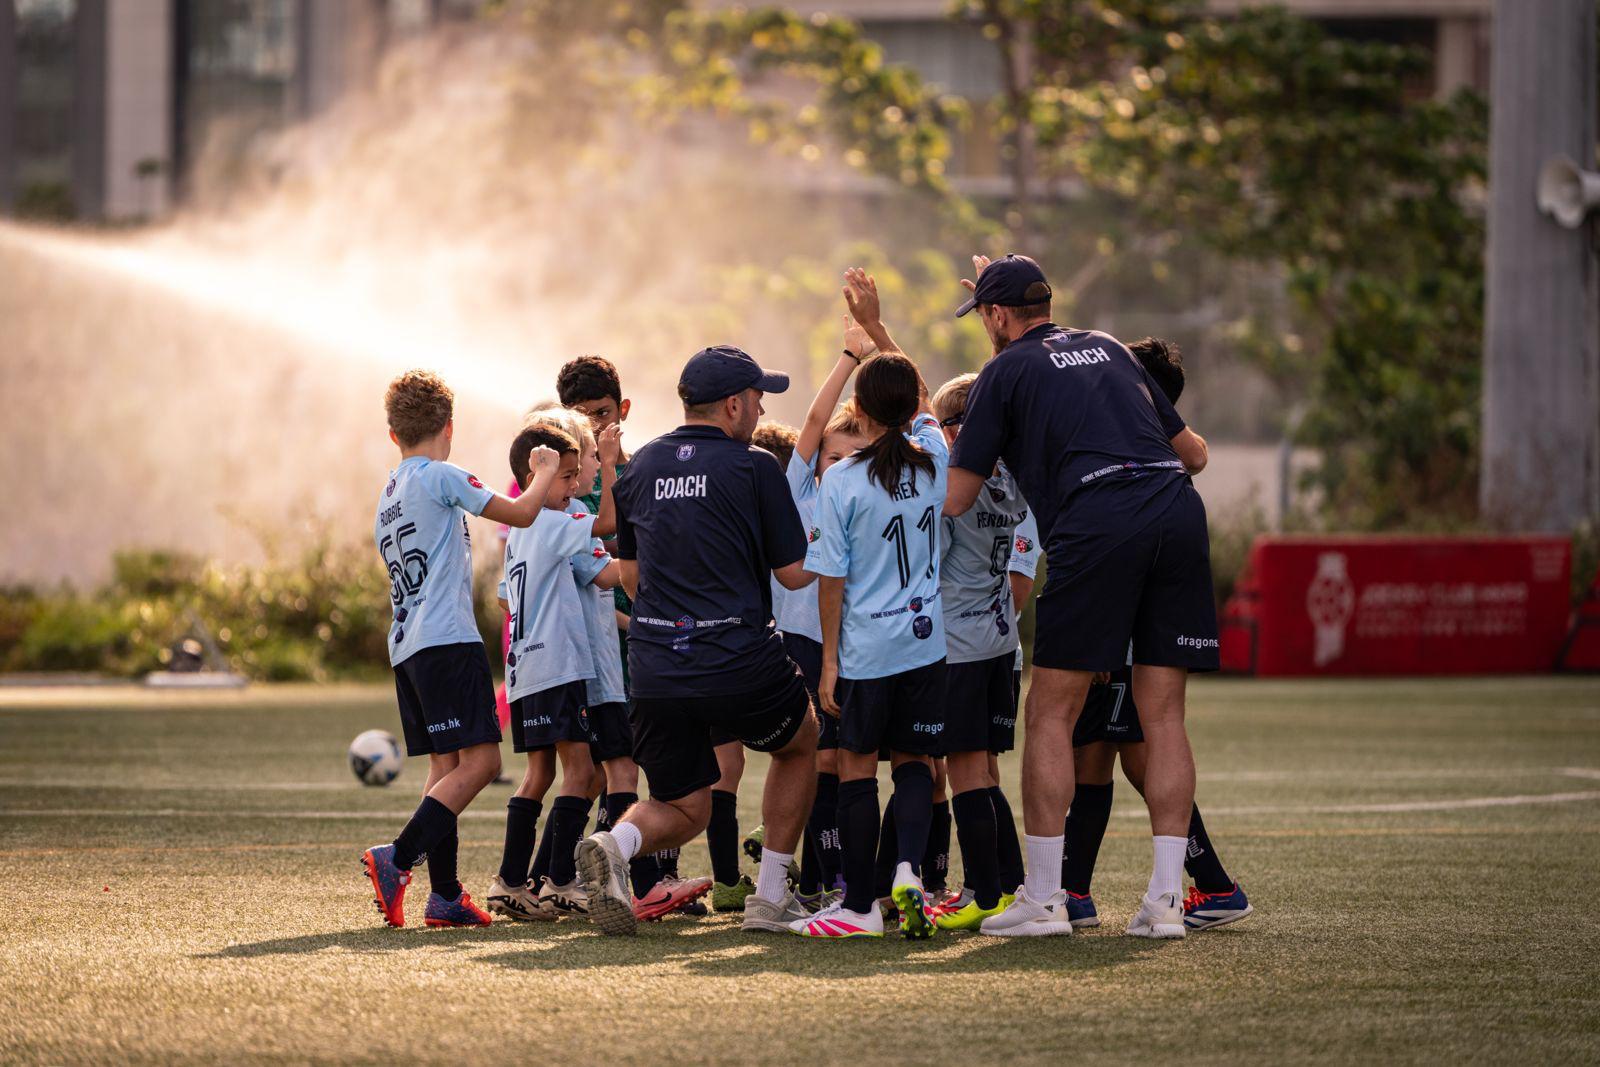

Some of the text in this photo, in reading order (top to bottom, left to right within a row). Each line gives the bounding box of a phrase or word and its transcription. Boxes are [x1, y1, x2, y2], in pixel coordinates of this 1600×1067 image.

[1050, 347, 1111, 369] COACH
[655, 475, 707, 500] COACH
[381, 501, 403, 527] ROBBIE
[882, 505, 935, 590] 11
[380, 522, 428, 605] 66
[1110, 682, 1126, 722] 7
[427, 718, 461, 733] ons.hk
[523, 715, 551, 727] ons.hk
